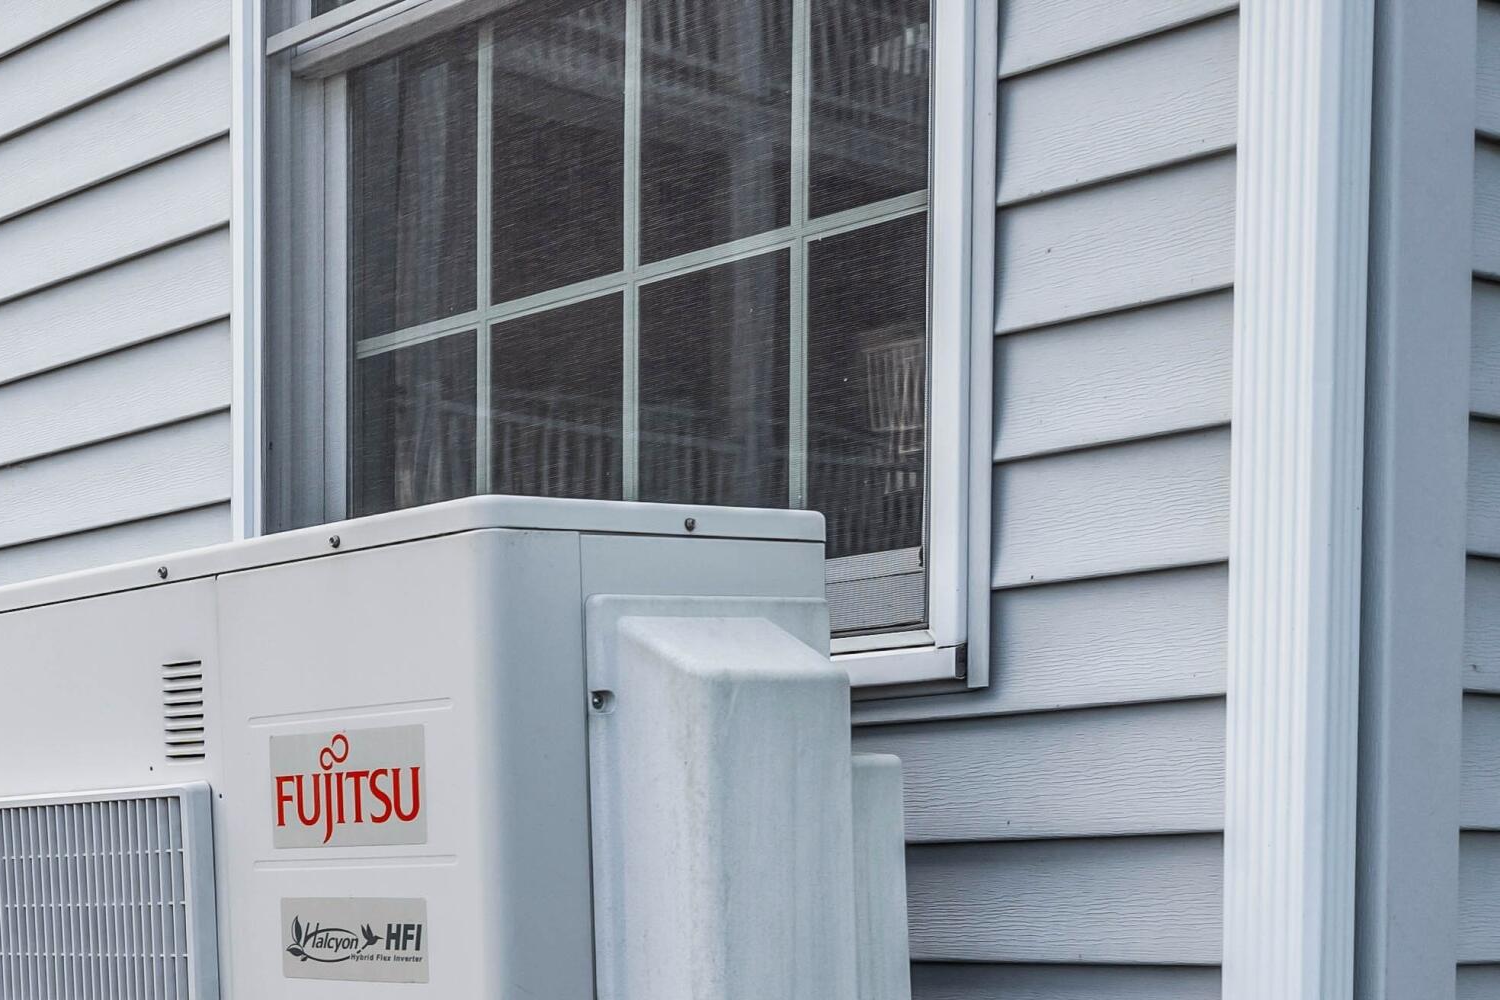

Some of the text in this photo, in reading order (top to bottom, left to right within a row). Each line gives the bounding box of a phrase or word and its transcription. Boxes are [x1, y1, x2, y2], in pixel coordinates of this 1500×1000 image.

[275, 765, 421, 844] FUJITSU
[302, 922, 423, 953] Halcyon HFI
[350, 952, 423, 963] Hybrid Flex Inverter
